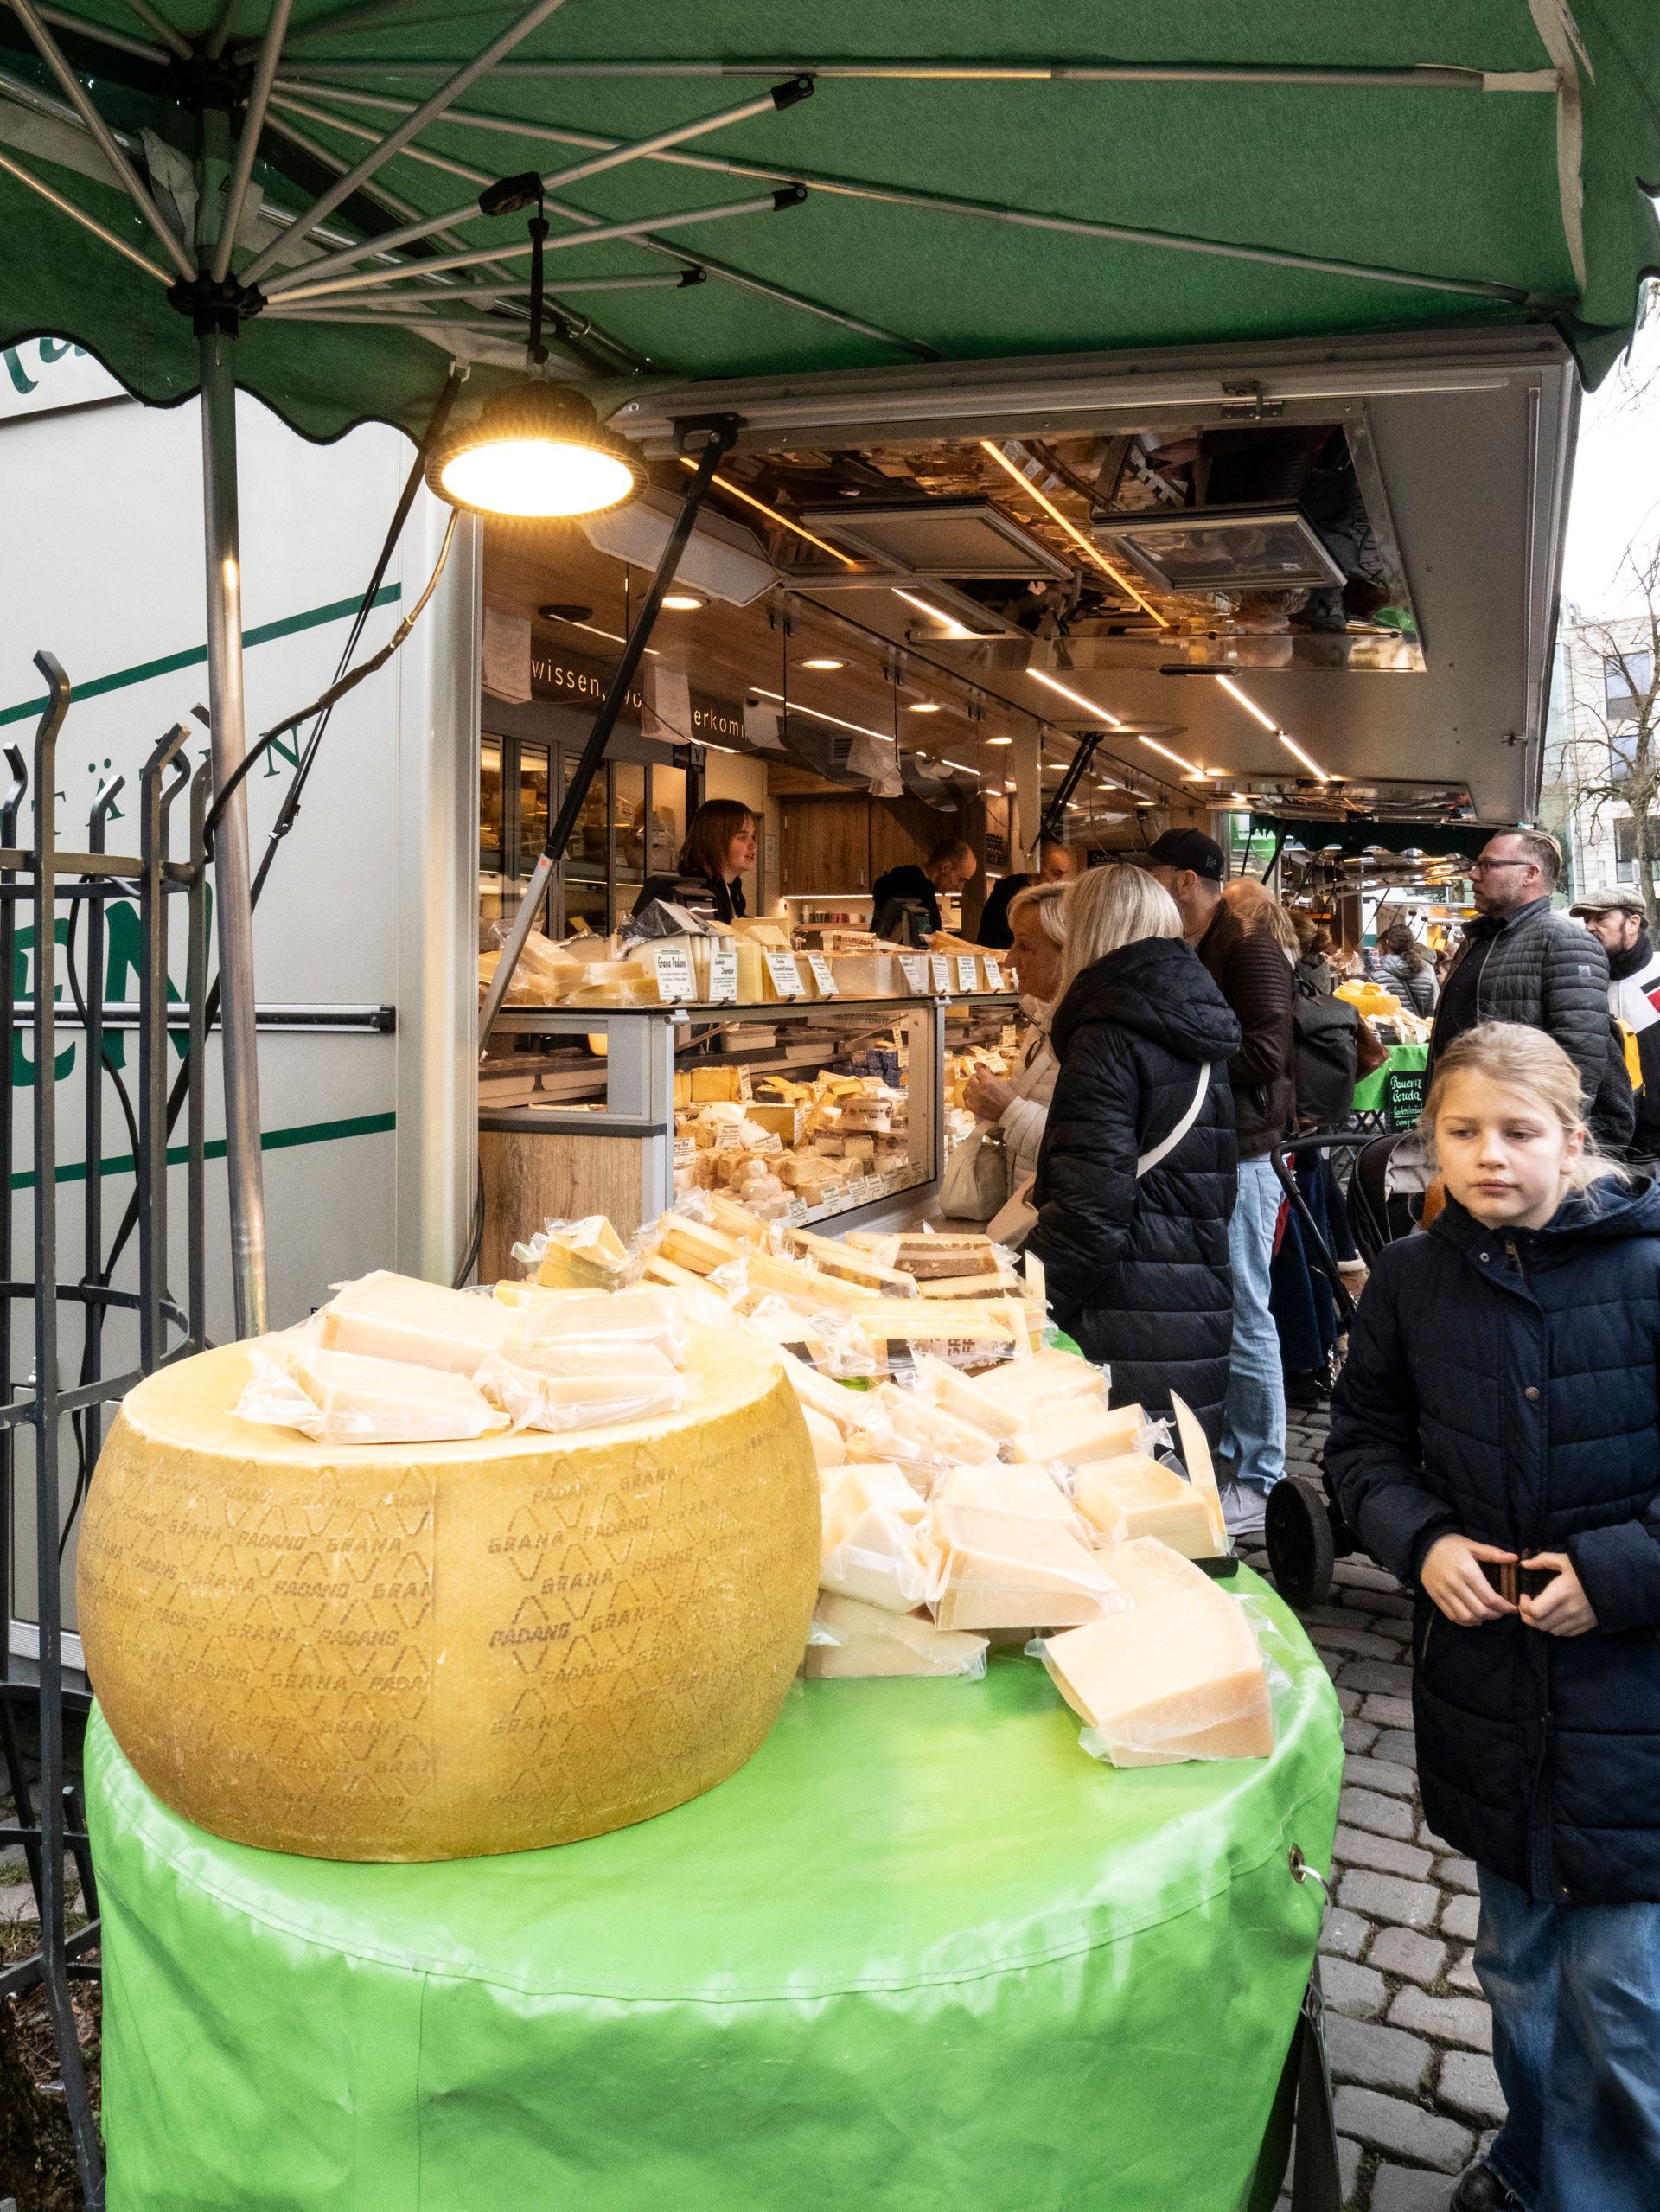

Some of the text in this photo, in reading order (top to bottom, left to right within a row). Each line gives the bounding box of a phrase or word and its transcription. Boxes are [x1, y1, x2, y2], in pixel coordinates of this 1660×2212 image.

[1390, 1075, 1422, 1090] Bauern
[1392, 1090, 1422, 1103] Gouda
[326, 1537, 402, 1554] GRANA
[488, 1531, 565, 1554] GRANA
[540, 1568, 614, 1595] GRANA
[489, 1621, 571, 1649] PADANO
